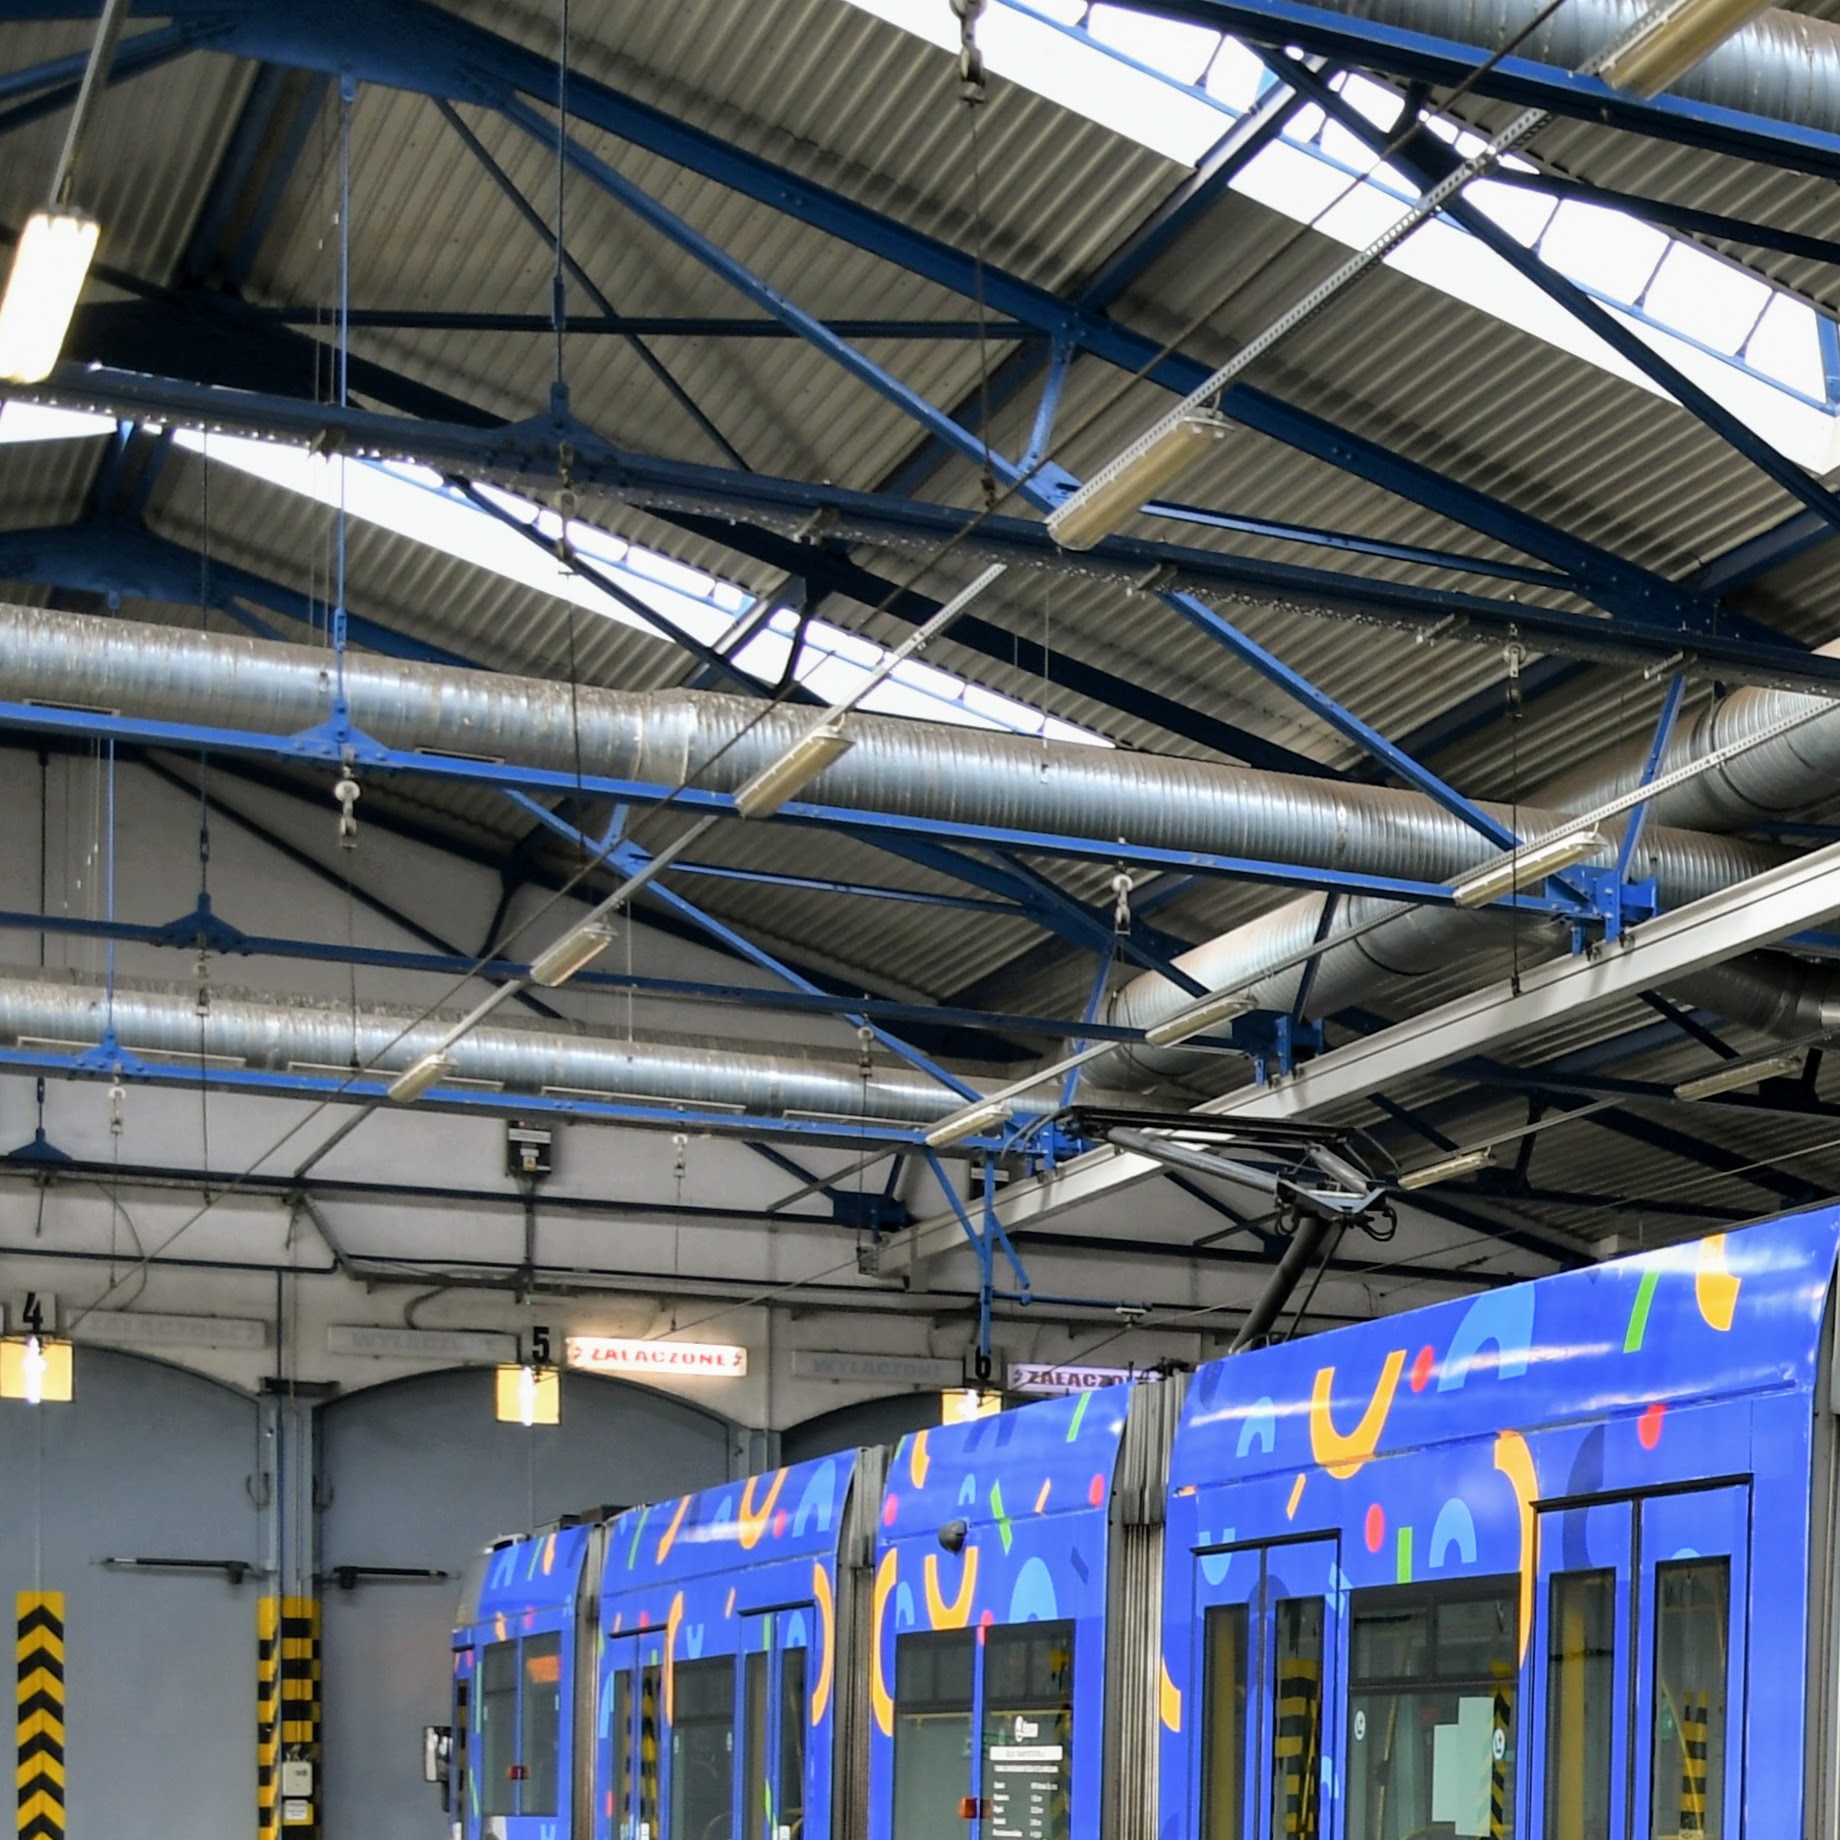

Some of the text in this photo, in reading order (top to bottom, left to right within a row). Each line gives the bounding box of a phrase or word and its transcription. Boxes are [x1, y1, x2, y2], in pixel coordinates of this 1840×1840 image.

[23, 1291, 43, 1333] 4
[532, 1326, 550, 1363] 5
[975, 1347, 991, 1379] 6
